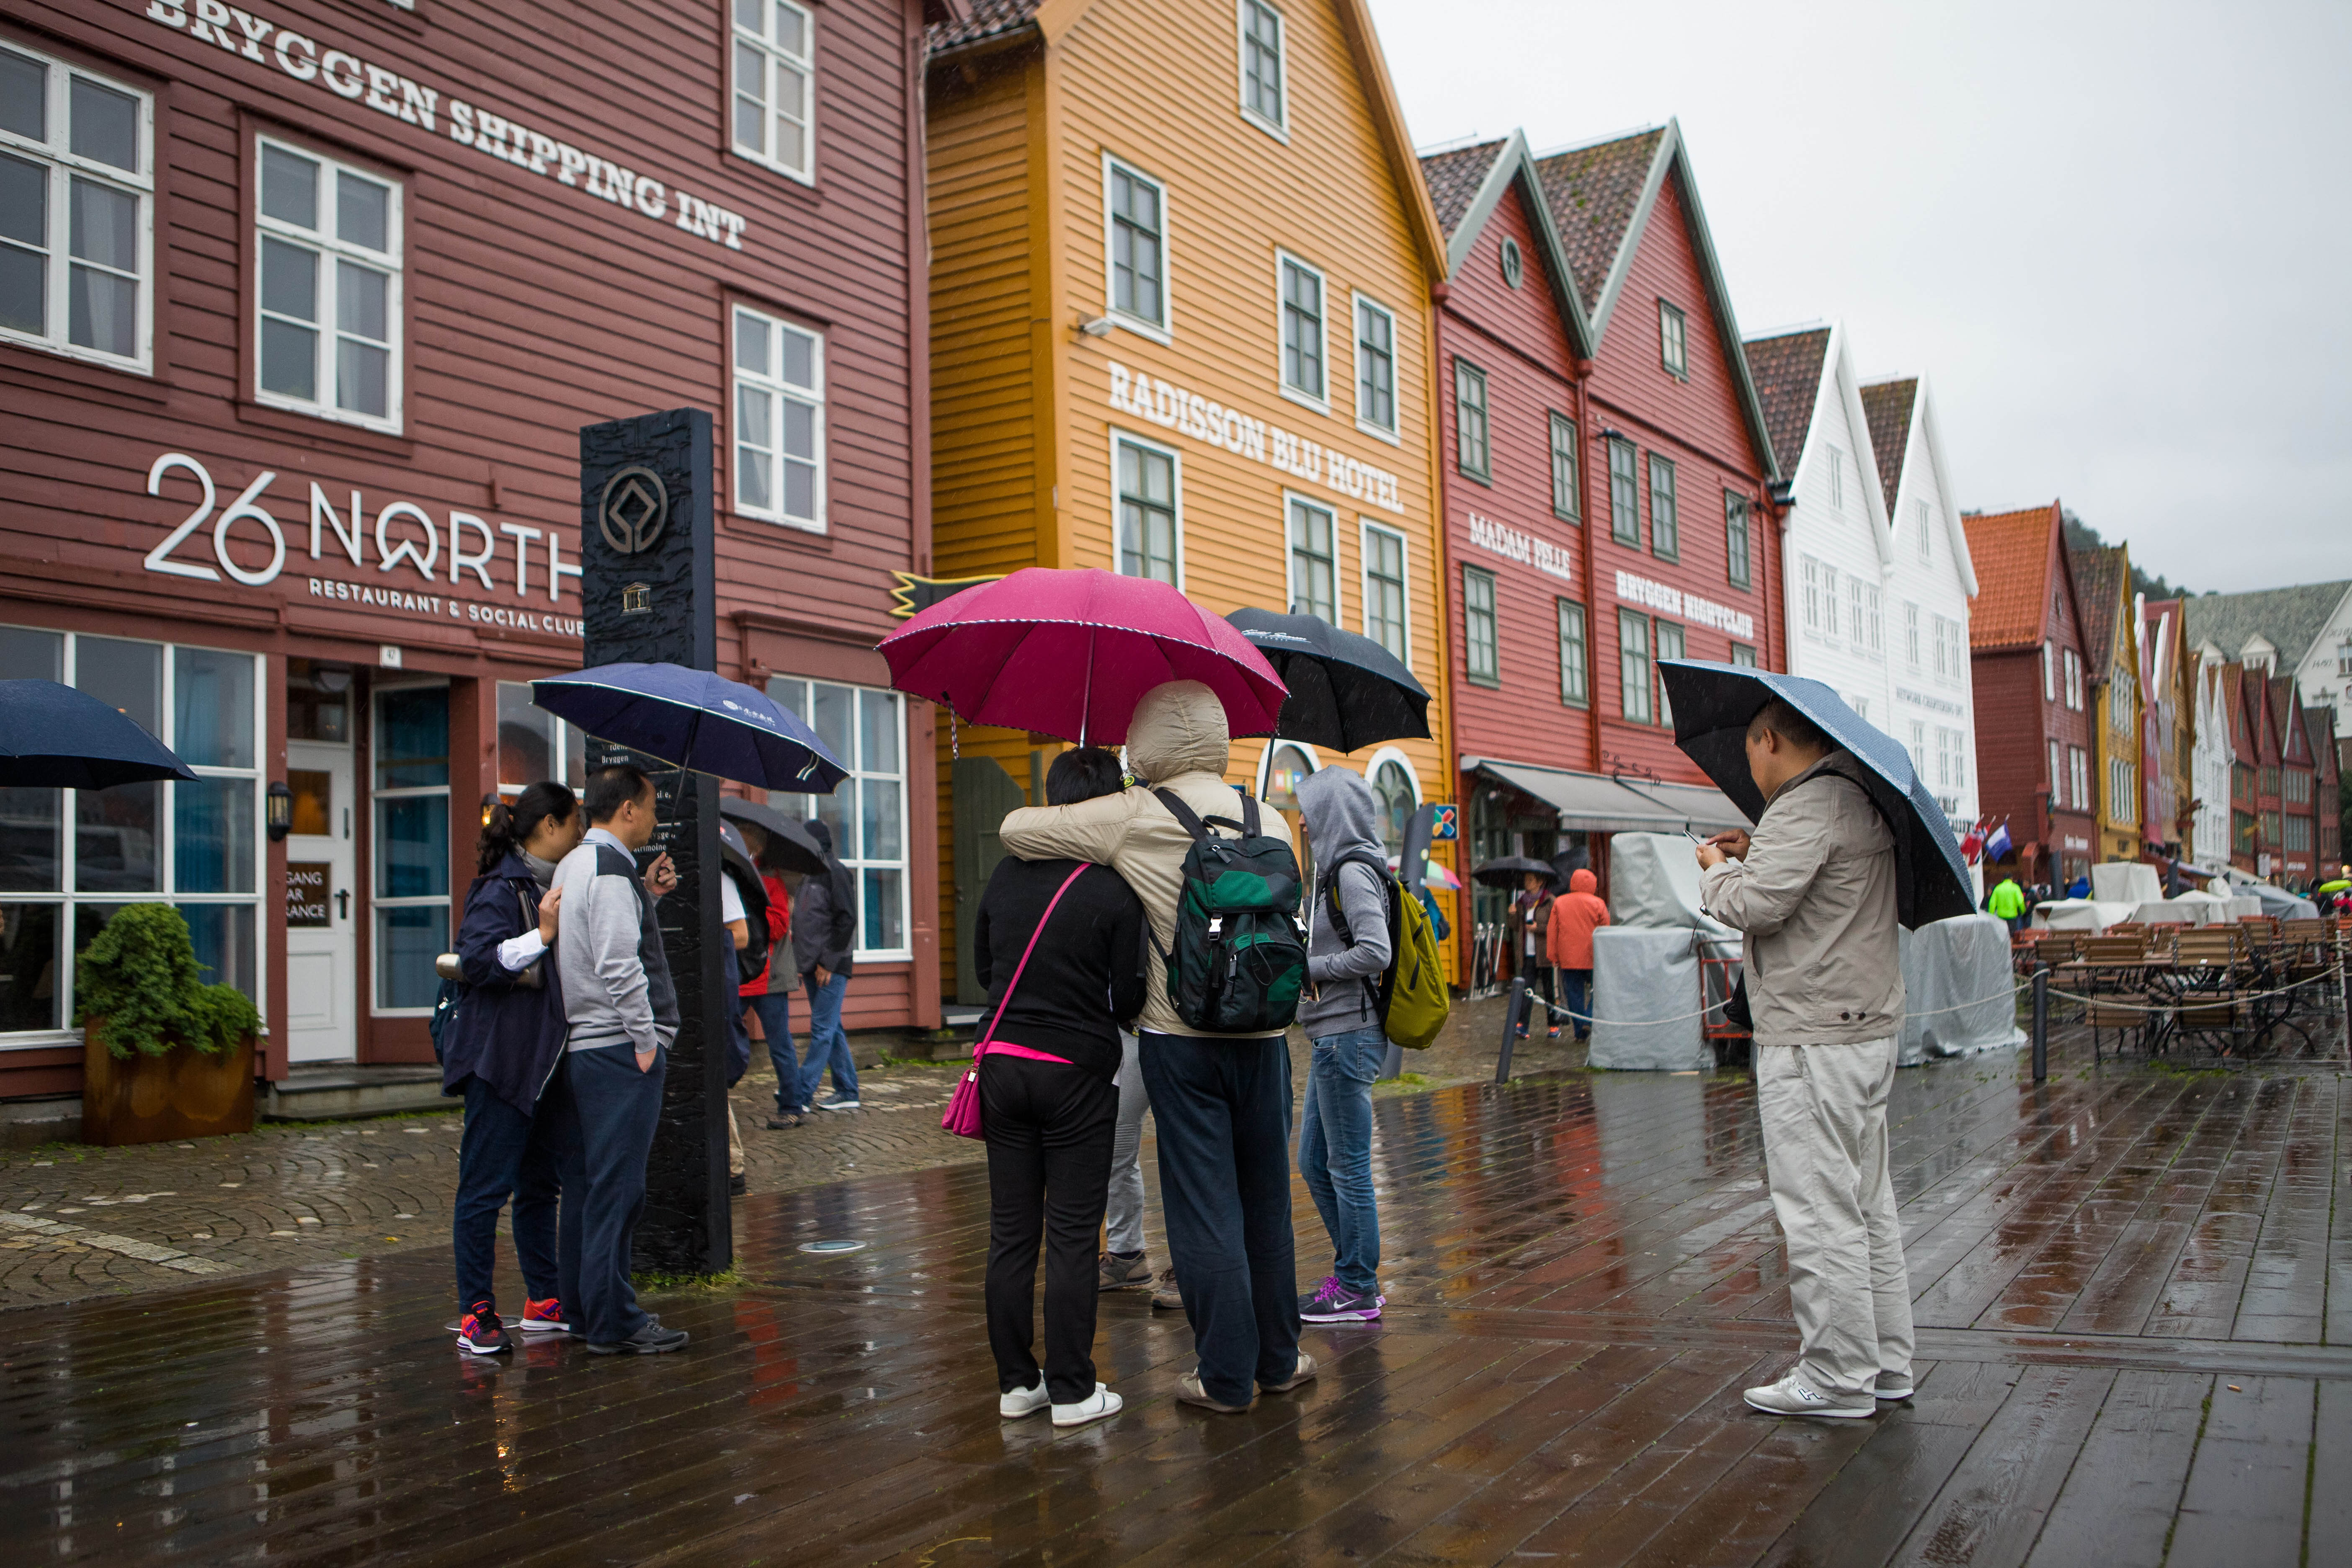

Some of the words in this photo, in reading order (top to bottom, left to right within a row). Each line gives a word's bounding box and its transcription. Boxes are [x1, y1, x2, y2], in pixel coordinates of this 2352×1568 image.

[146, 0, 438, 130] BRYGGEN
[450, 100, 668, 219] SHIPPING
[675, 191, 746, 250] INT
[1108, 360, 1265, 462] RADISSON
[1271, 426, 1321, 482] BLU
[1327, 449, 1404, 515] HOTEL
[144, 453, 285, 584] 26
[311, 482, 583, 601] NORTH
[1469, 512, 1531, 565] MADAM
[1534, 537, 1571, 580] FELLE
[309, 578, 440, 614] RESTAURANT
[449, 601, 460, 617] &
[468, 604, 539, 631] SOCIAL
[542, 615, 584, 636] CLUB
[1616, 570, 1681, 616] BRYGGEN
[1684, 593, 1754, 641] NIGHTCLUB
[602, 755, 628, 764] Bryggen
[657, 790, 671, 799] sie,
